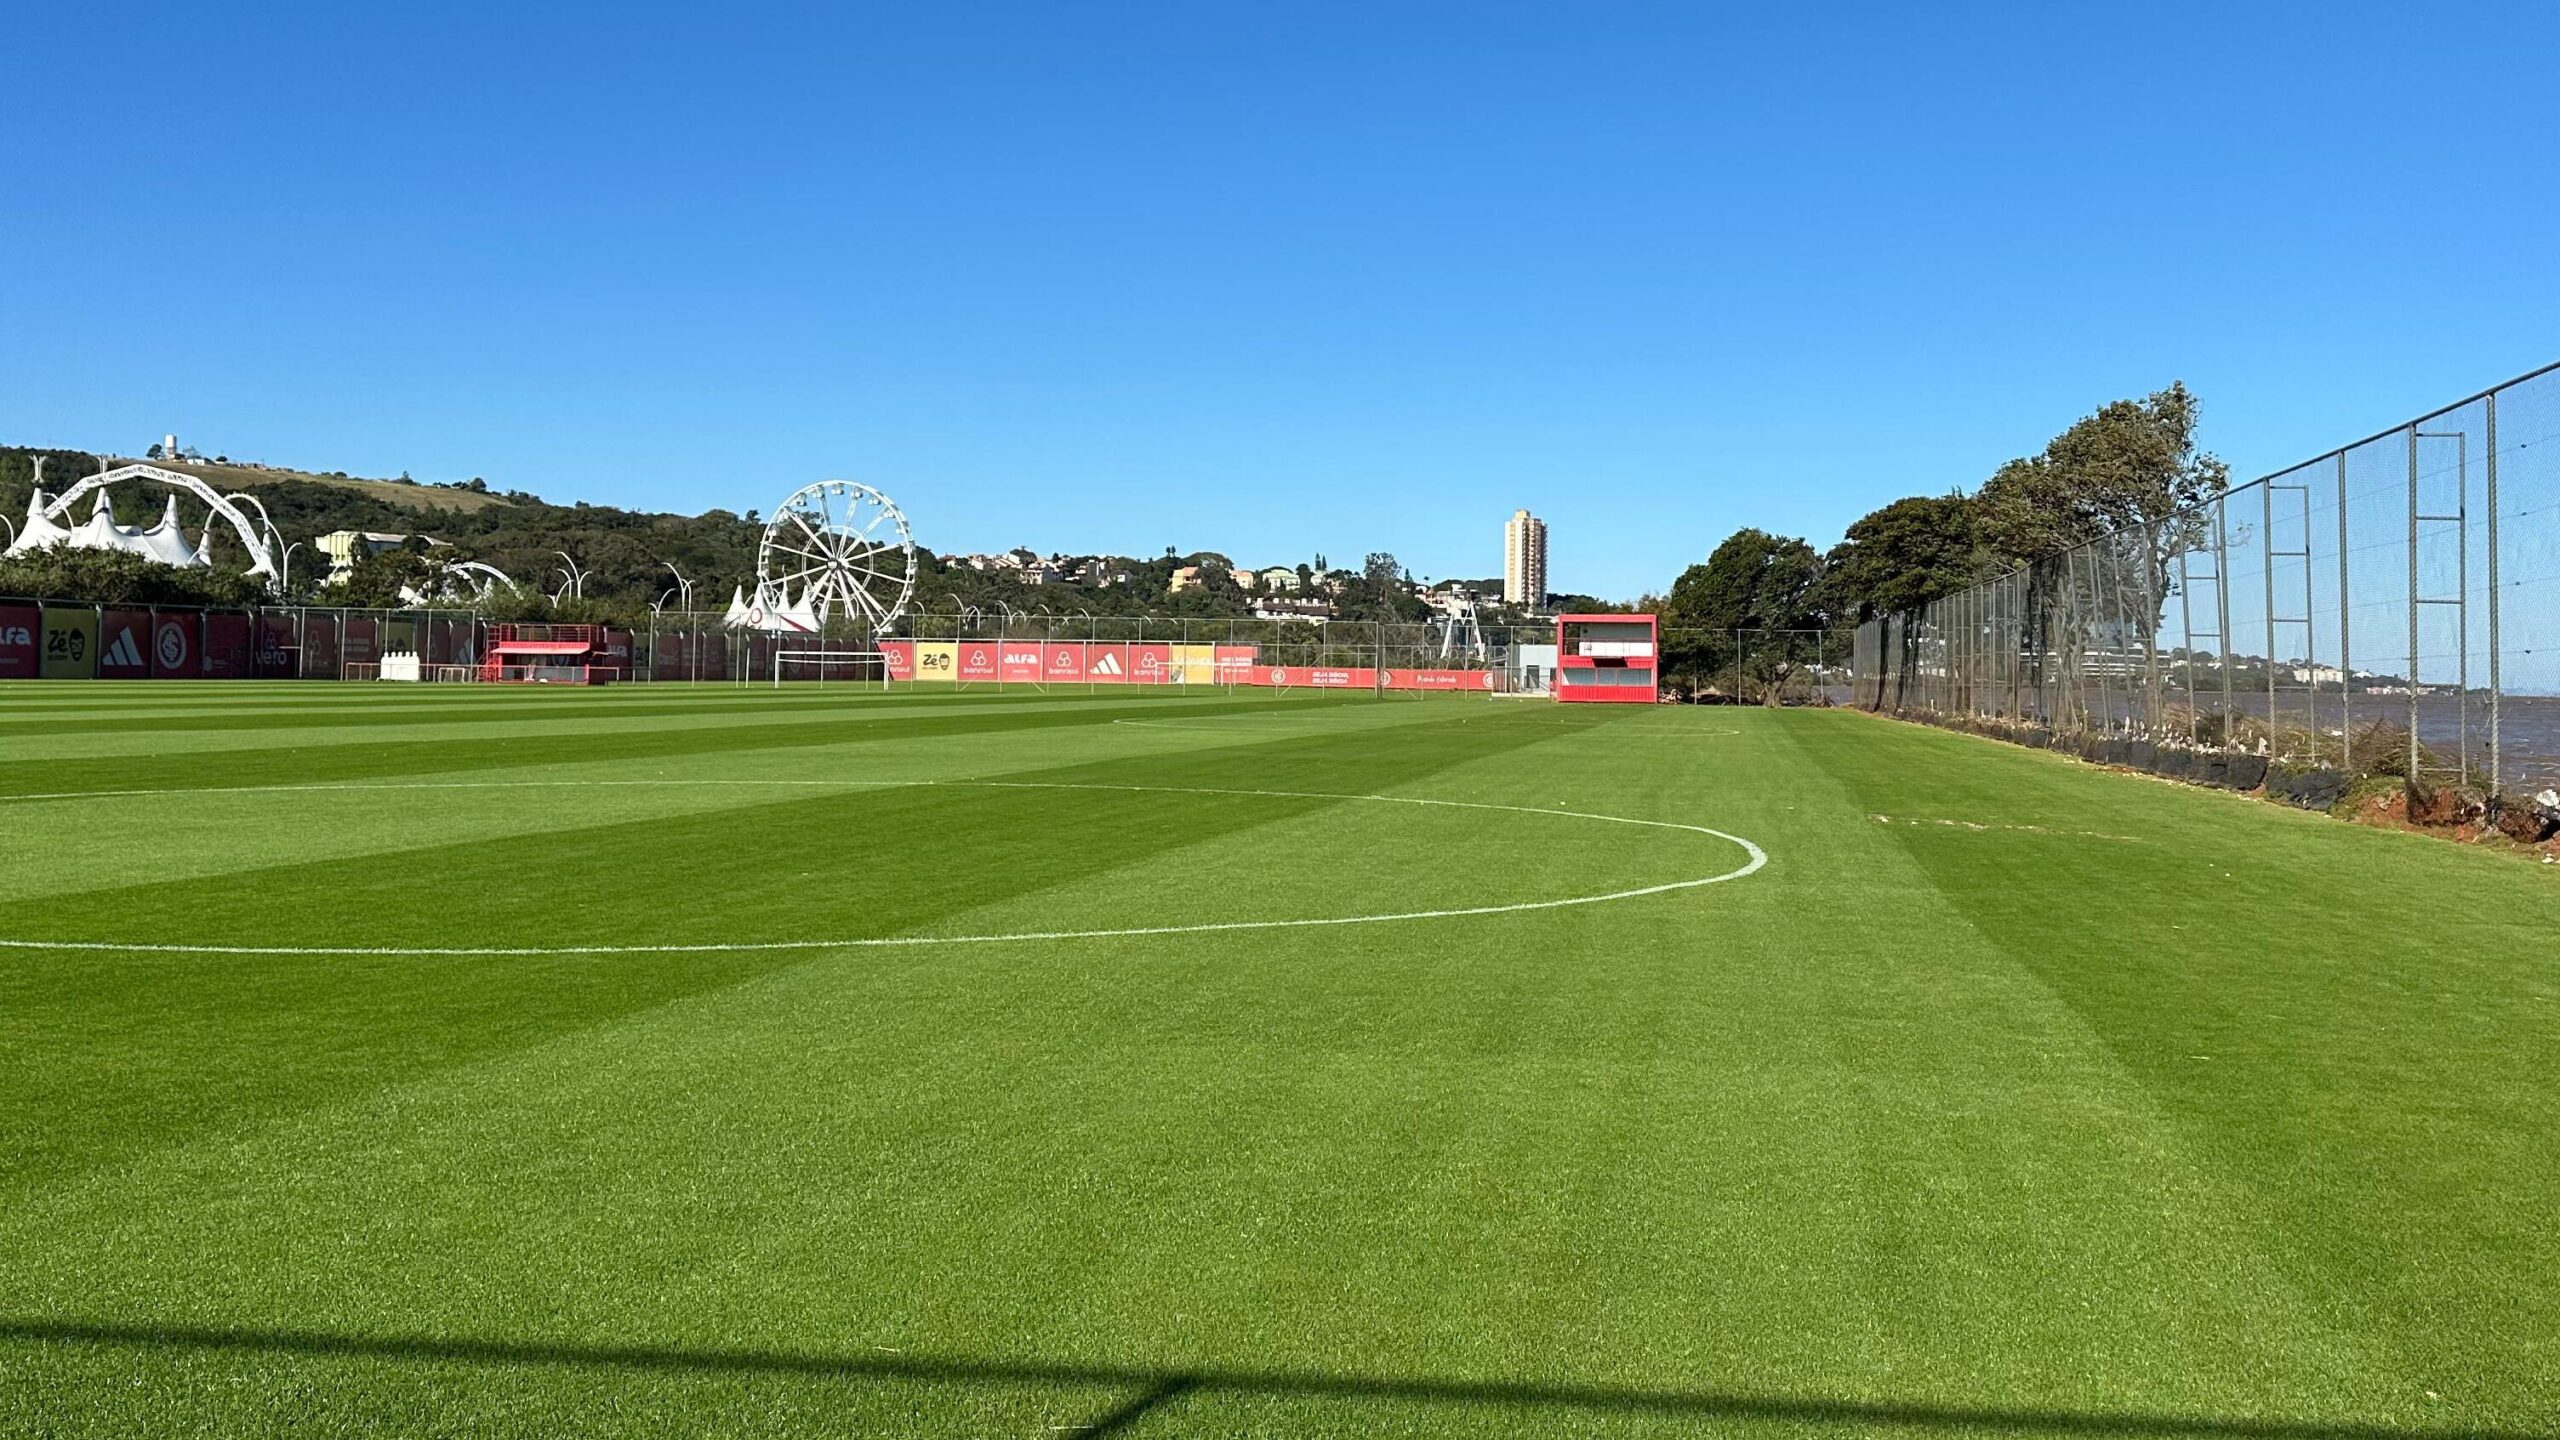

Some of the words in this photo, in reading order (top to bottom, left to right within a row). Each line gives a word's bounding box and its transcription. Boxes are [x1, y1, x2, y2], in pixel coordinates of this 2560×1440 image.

[48, 629, 68, 653] Zé
[255, 650, 287, 665] vero
[922, 654, 938, 666] Zé
[963, 666, 993, 674] banrisul
